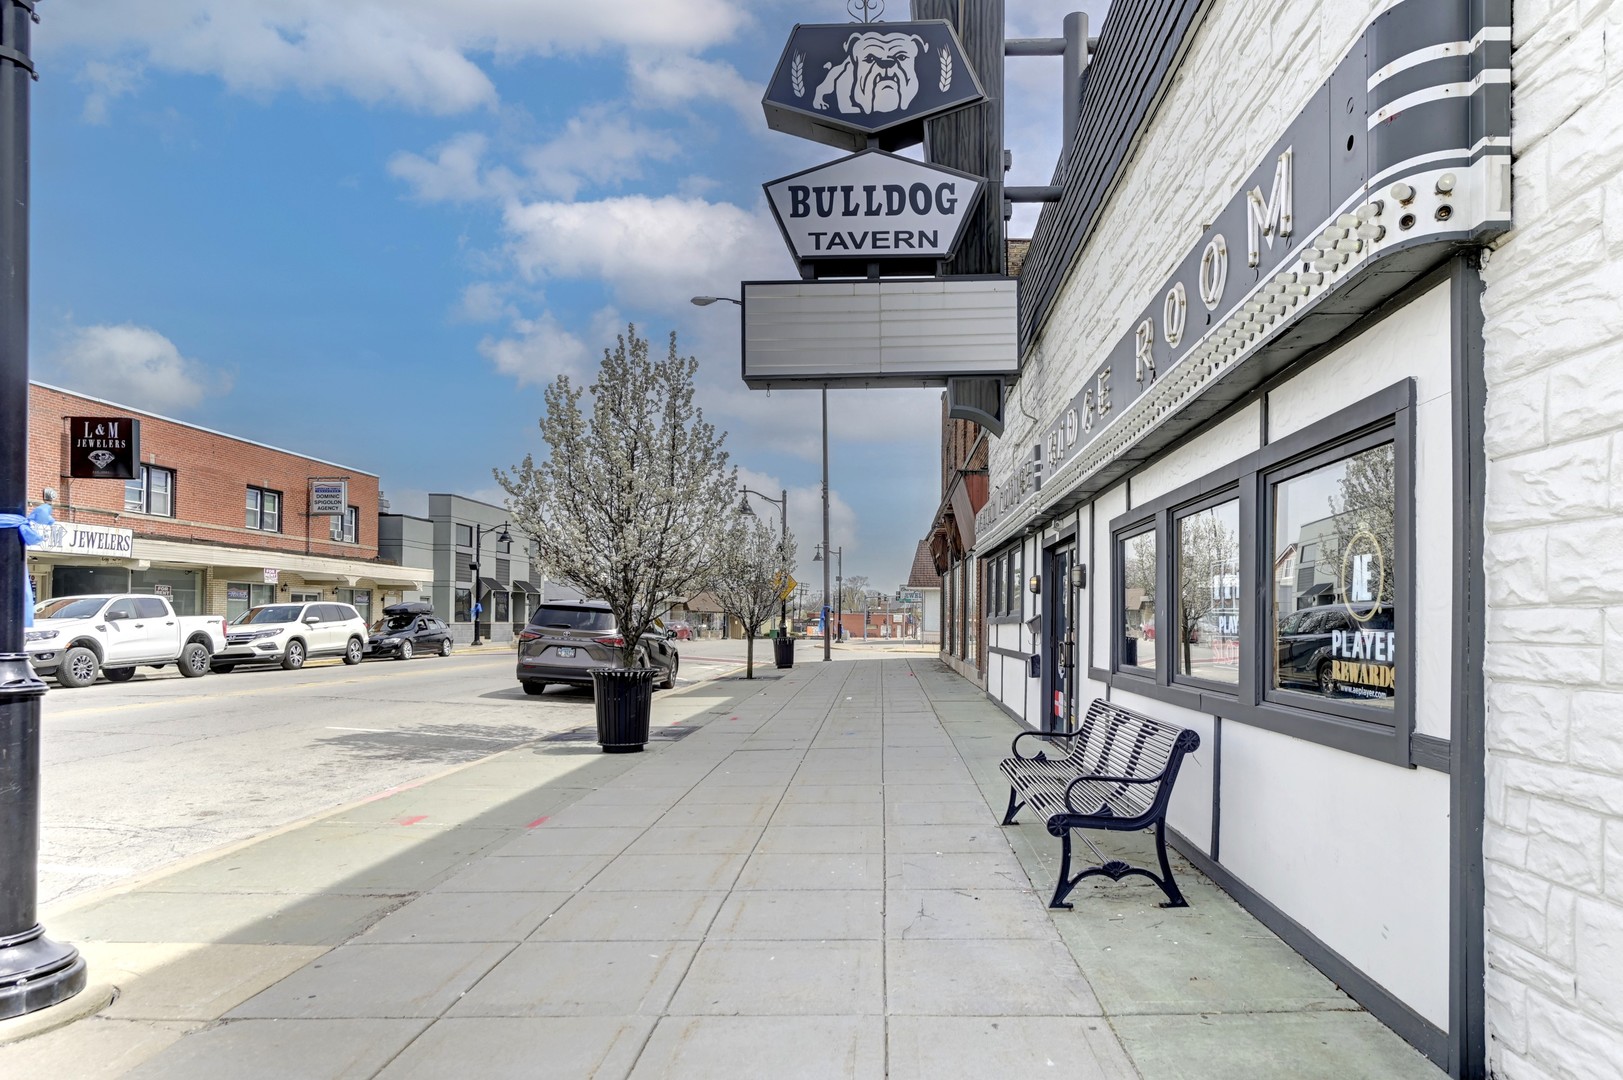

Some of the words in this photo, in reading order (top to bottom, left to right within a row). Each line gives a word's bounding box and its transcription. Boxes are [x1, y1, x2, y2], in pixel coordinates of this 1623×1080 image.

[787, 182, 958, 219] BULLDOG
[808, 230, 939, 250] TAVERN
[1047, 366, 1112, 466] RIDGE
[1135, 145, 1294, 384] ROOM
[84, 421, 93, 438] L
[95, 424, 105, 435] &
[108, 422, 119, 438] M
[77, 439, 126, 448] JEWELERS
[69, 530, 131, 552] JEWELERS
[1351, 553, 1373, 602] AE
[1218, 615, 1239, 634] PLAY
[1340, 685, 1387, 700] www.aeplayer.com
